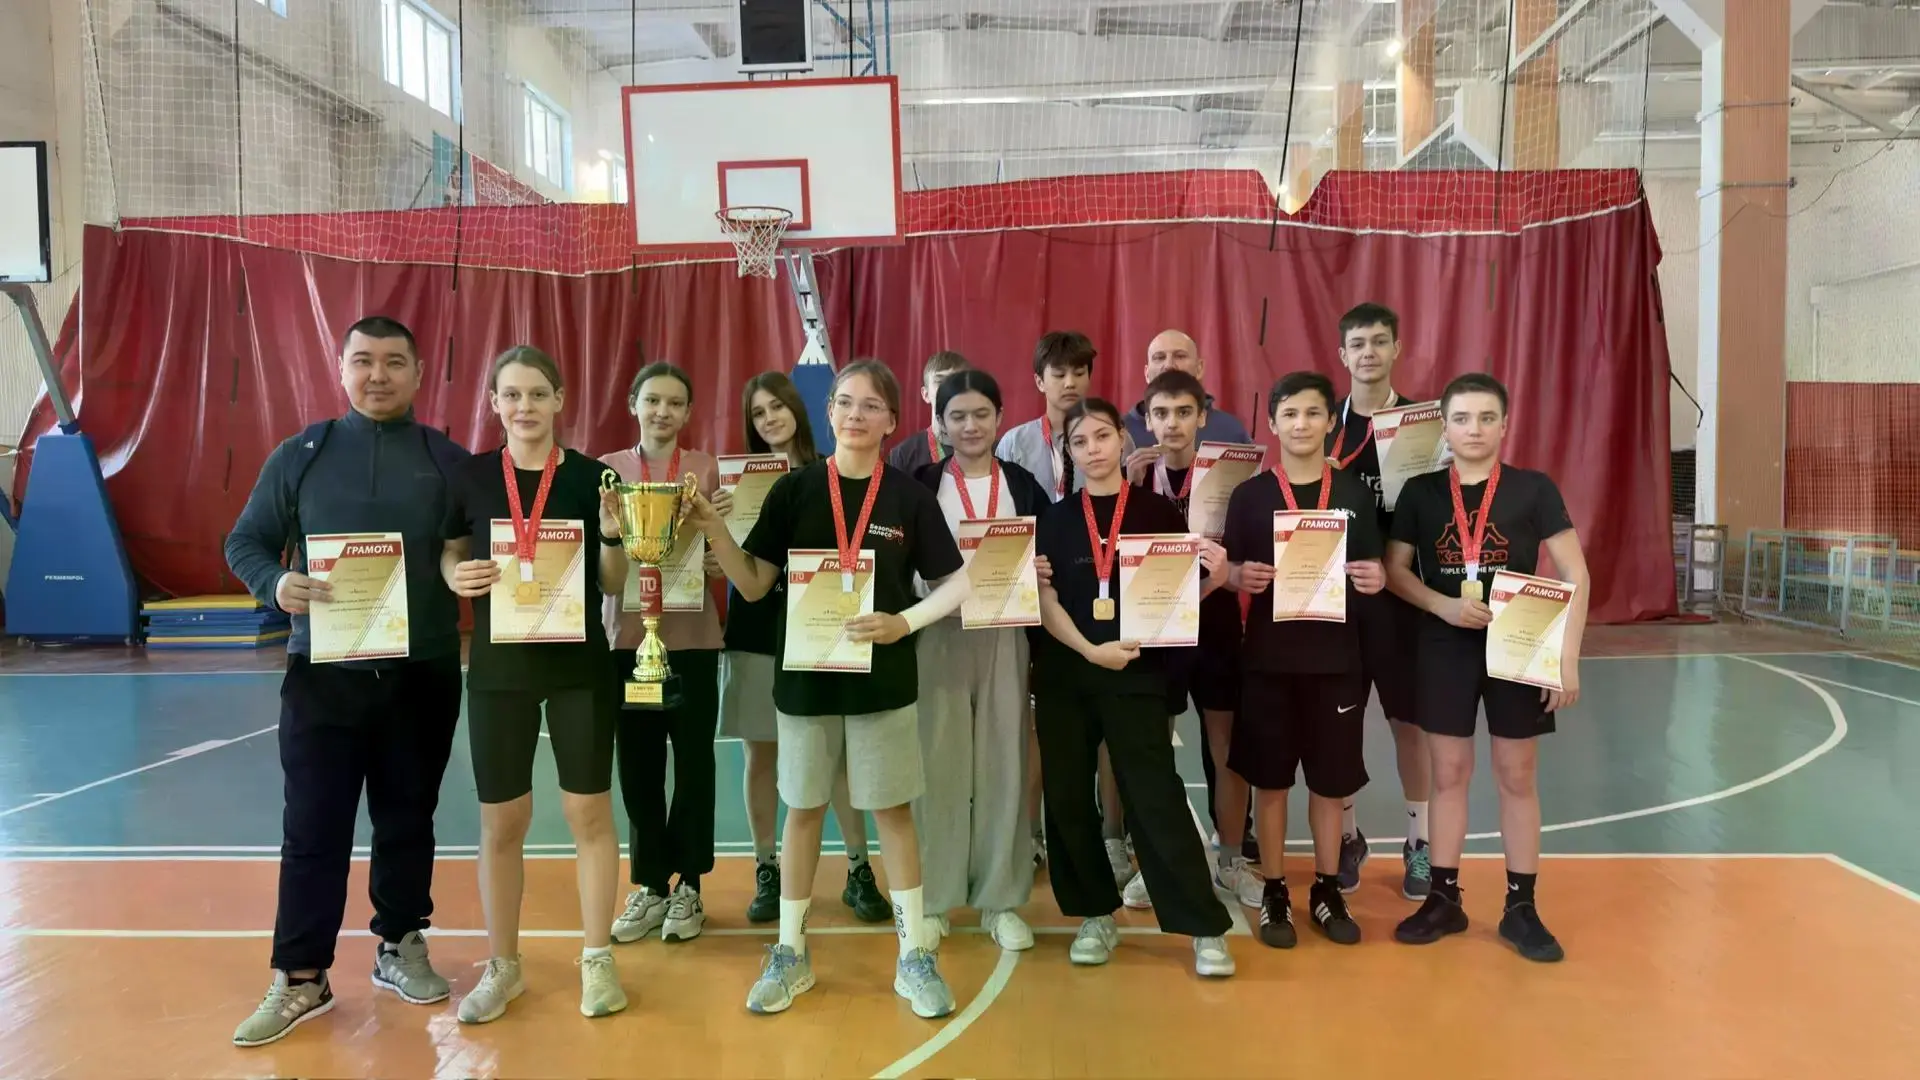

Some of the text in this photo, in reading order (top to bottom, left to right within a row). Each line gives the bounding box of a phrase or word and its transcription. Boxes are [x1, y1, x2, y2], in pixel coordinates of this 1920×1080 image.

[1404, 410, 1442, 422] ГРАМОТА
[1224, 451, 1257, 460] ГРАМОТА
[747, 462, 783, 471] ГРАМОТА
[1301, 520, 1340, 529] ГРАМОТА
[537, 531, 575, 540] АМОТА
[990, 526, 1028, 535] ГРАМОТА
[346, 545, 394, 555] ГРАМОТА
[1151, 544, 1192, 553] ГРАМОТА
[1437, 549, 1509, 565] Kapa
[310, 560, 326, 570] ГТО
[823, 560, 867, 570] ГРАТА
[640, 577, 657, 592] ТО
[1524, 585, 1565, 600] ГРАМОТА
